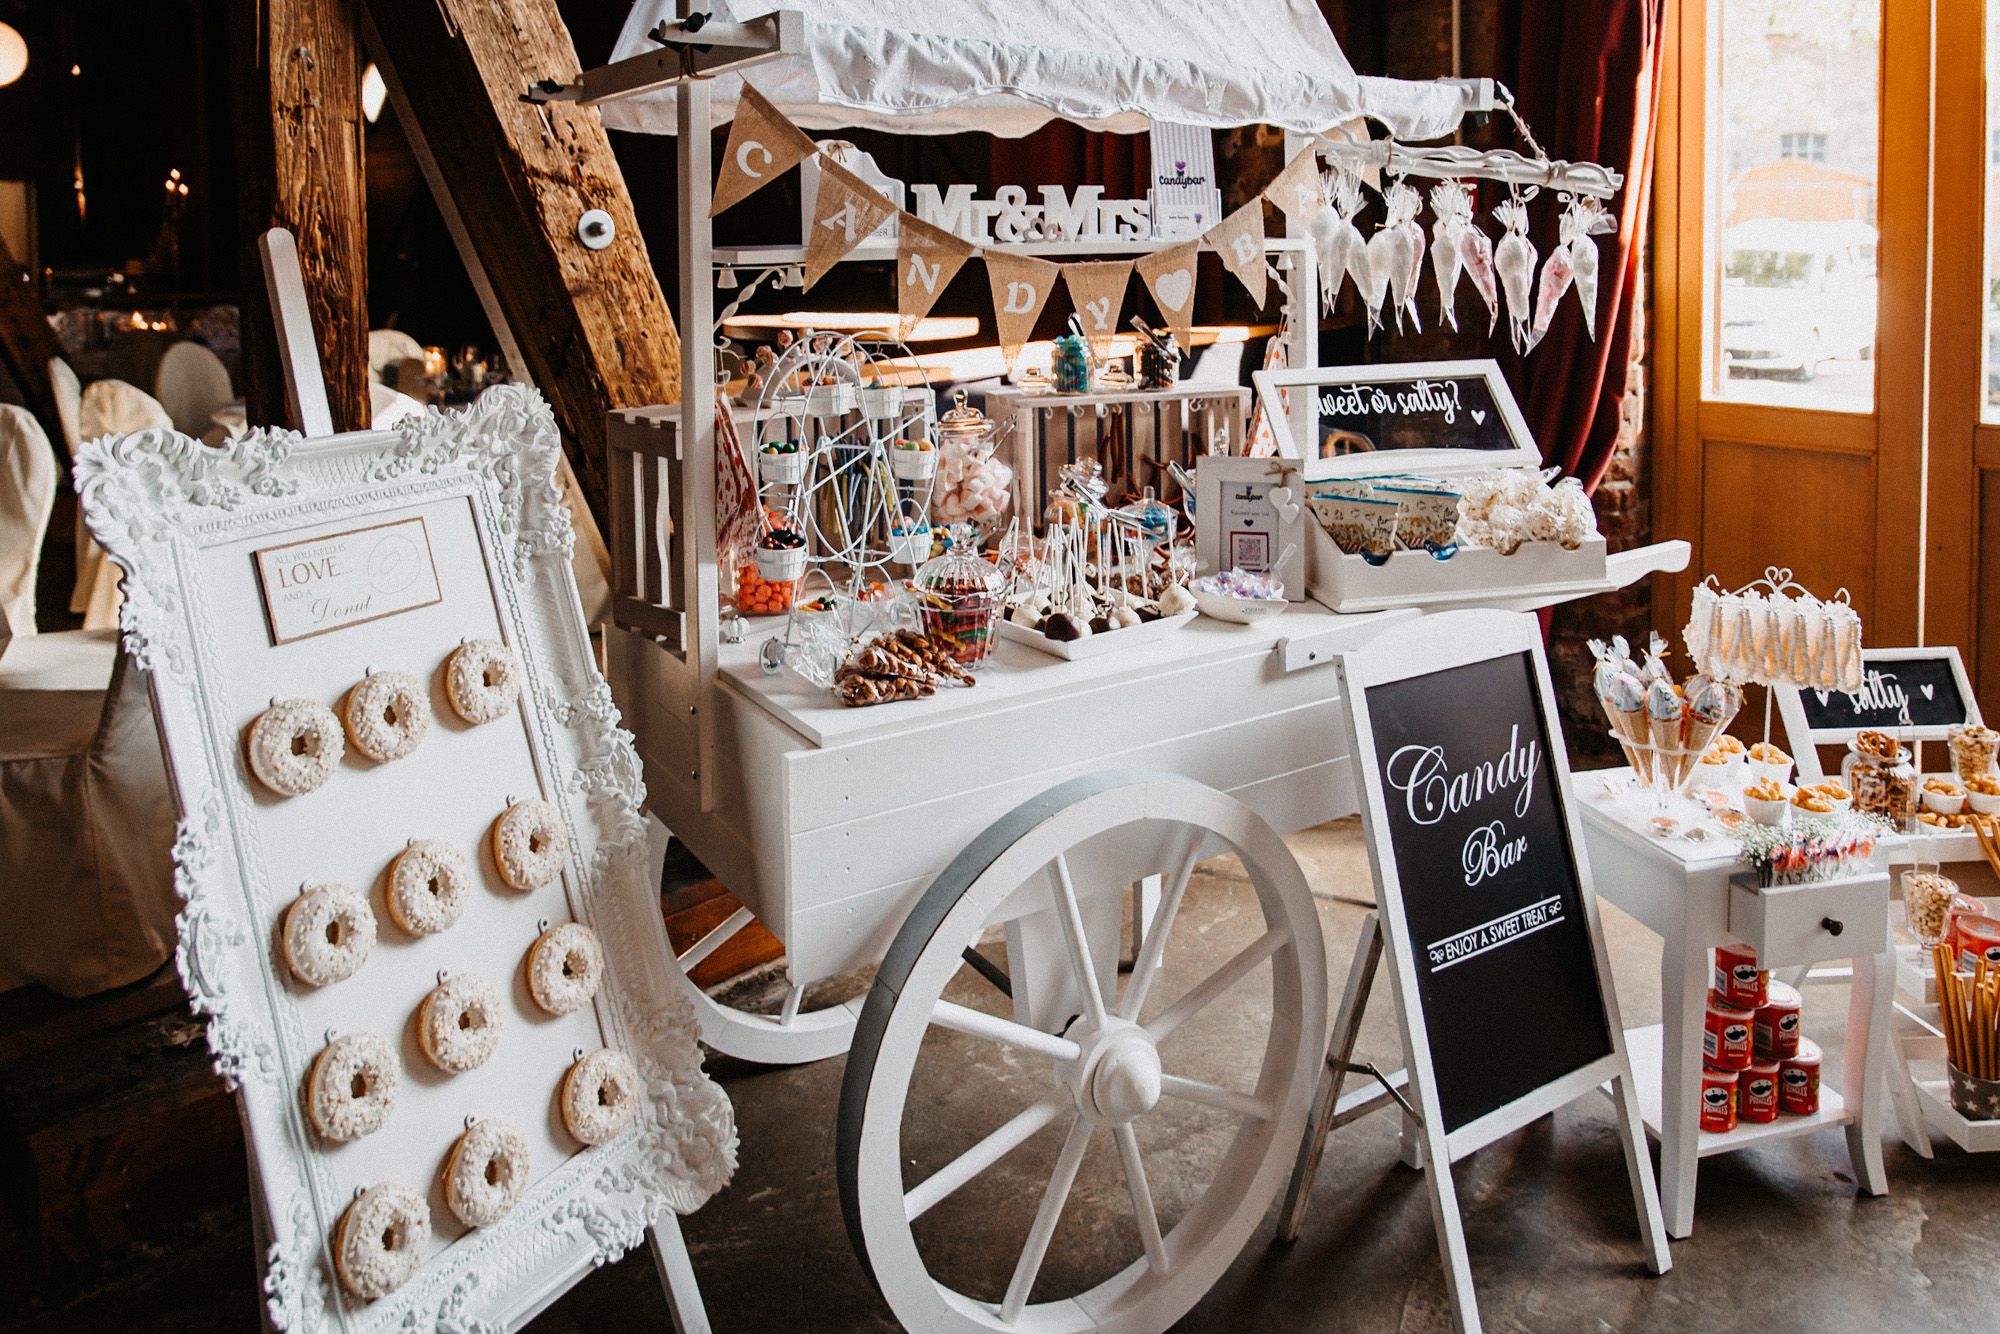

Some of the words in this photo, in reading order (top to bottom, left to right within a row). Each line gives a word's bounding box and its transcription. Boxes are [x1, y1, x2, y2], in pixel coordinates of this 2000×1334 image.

[1316, 383, 1373, 416] weet
[1371, 388, 1397, 414] or
[1397, 379, 1462, 424] salty?
[311, 594, 372, 624] Donut
[1386, 723, 1542, 825] Candy
[1462, 820, 1528, 887] Bar
[1445, 933, 1478, 960] ENJOY
[1481, 930, 1489, 947] A
[1489, 914, 1521, 943] SWEET
[1521, 905, 1548, 929] TREAT
